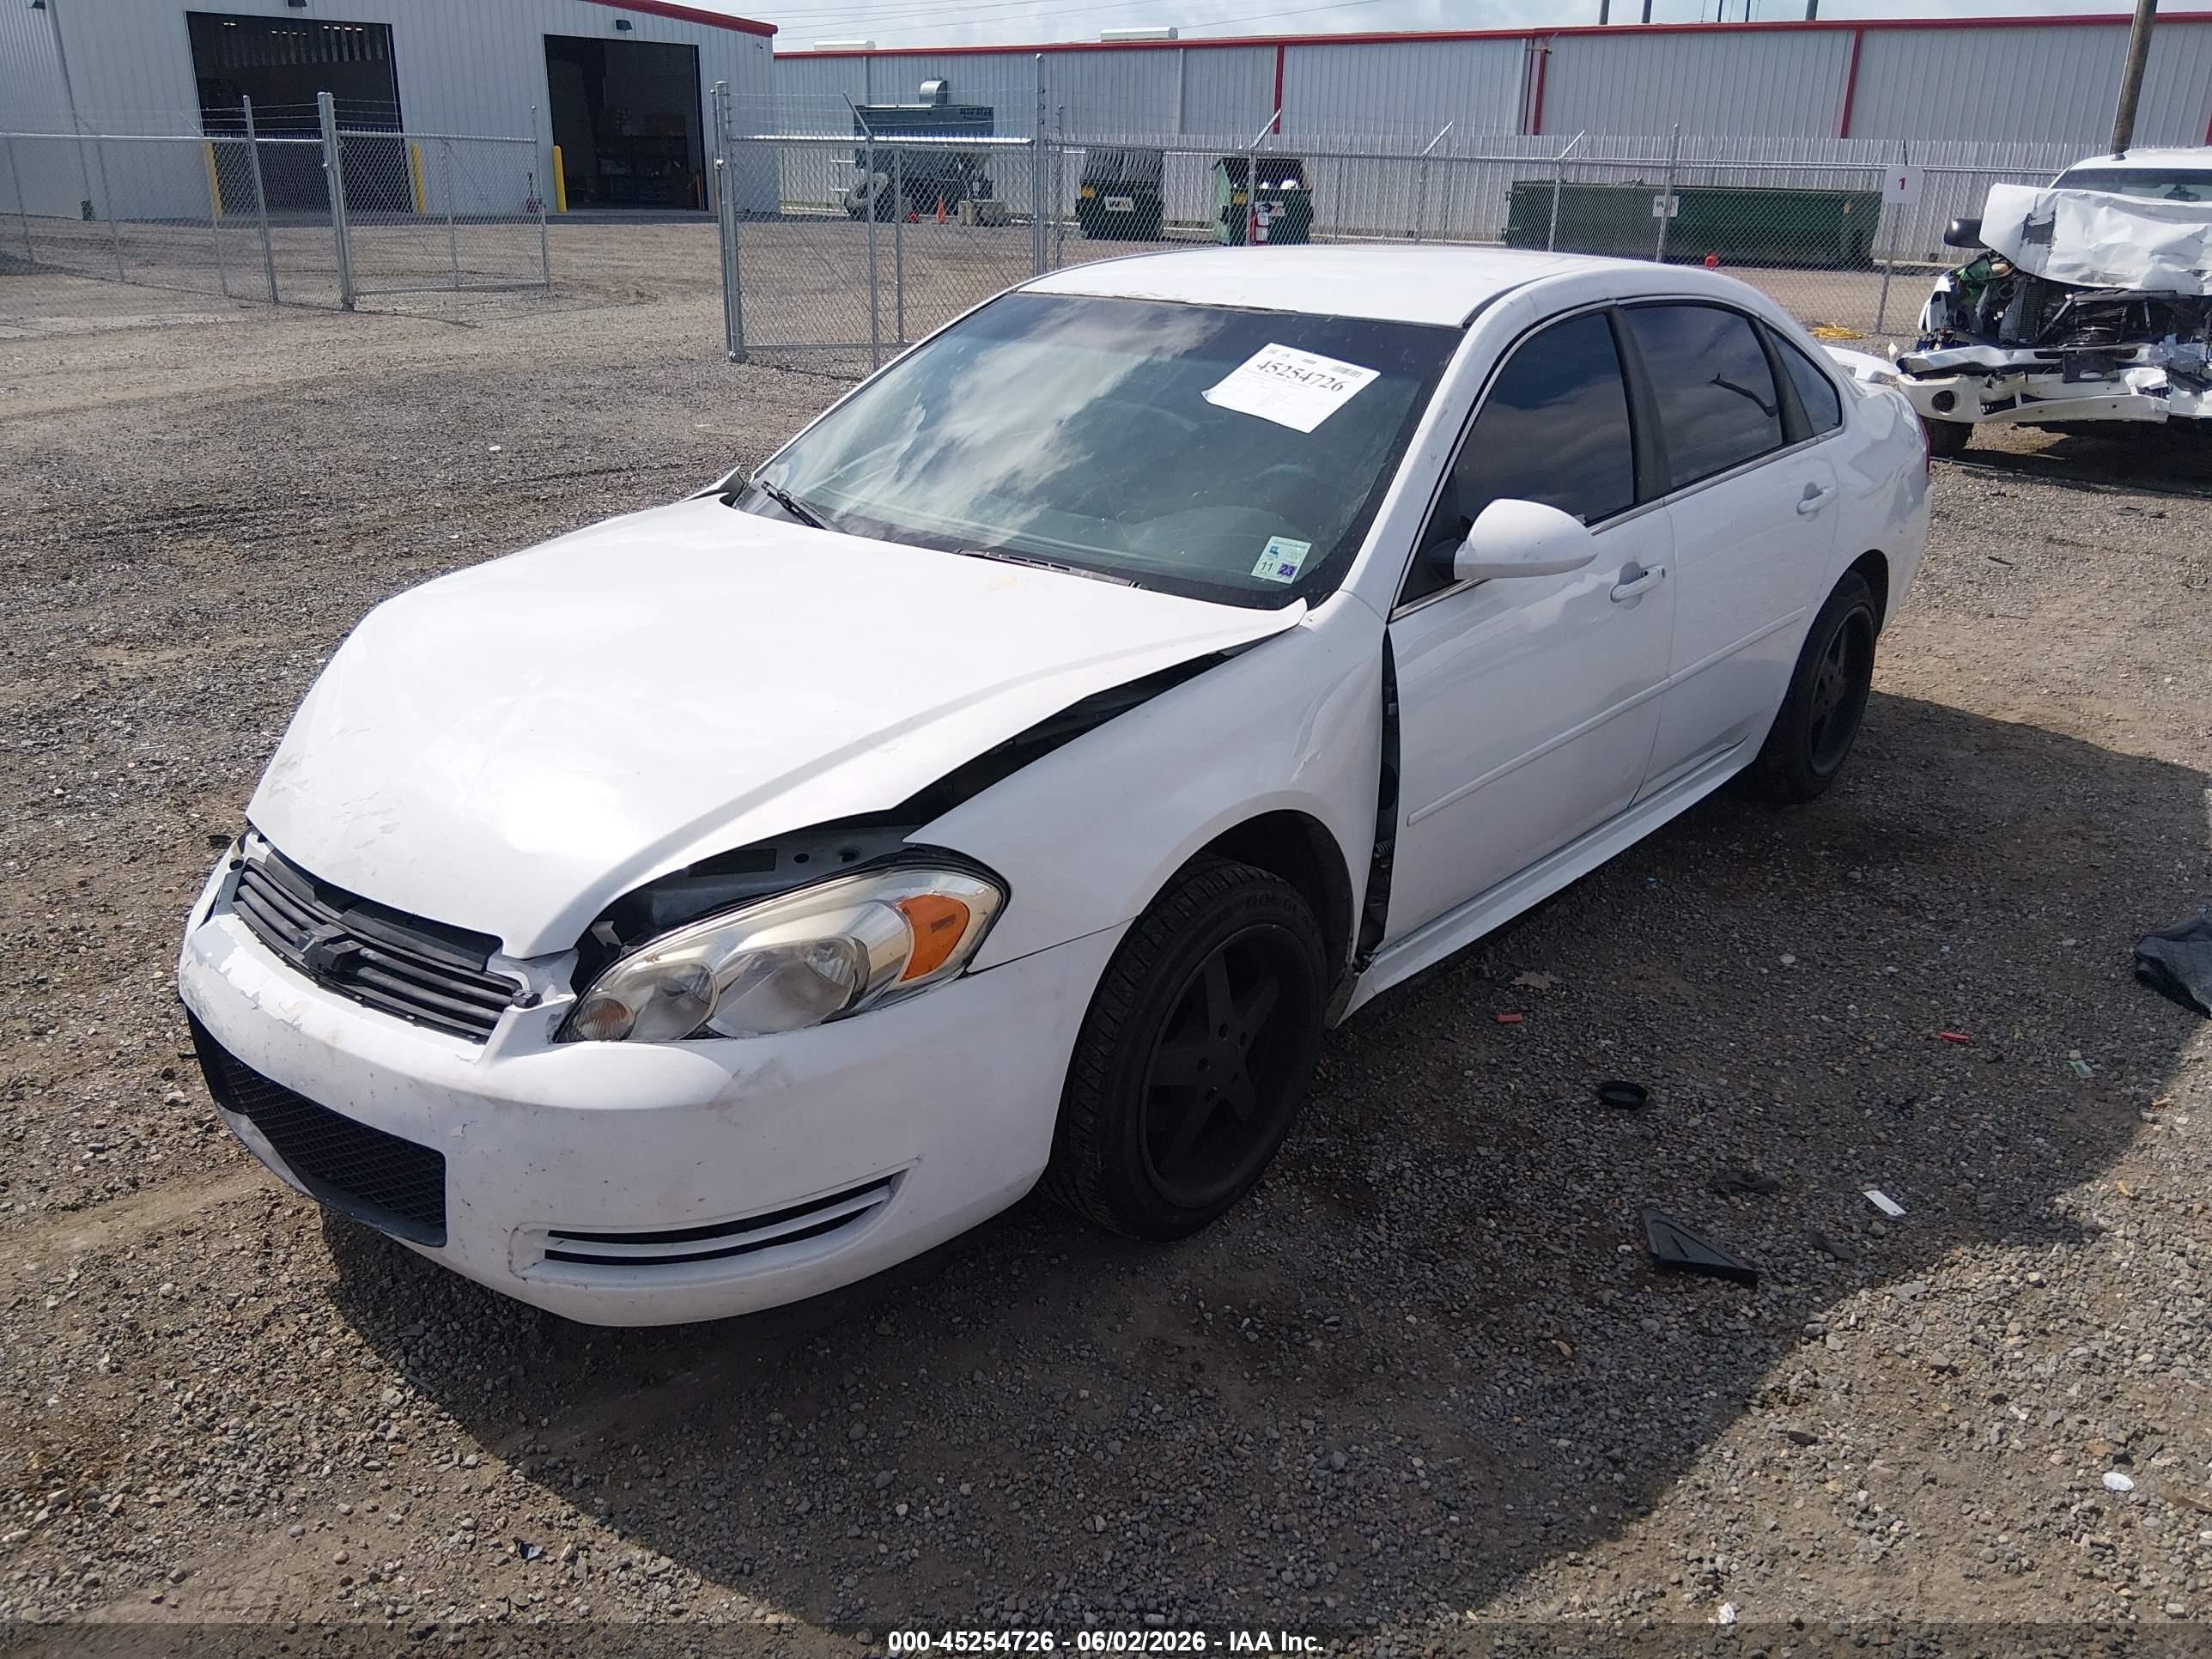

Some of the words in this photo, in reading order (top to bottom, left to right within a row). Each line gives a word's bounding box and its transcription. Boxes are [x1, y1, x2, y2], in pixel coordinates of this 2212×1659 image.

[1898, 177, 1906, 191] 1
[1256, 360, 1348, 392] 45254726
[1261, 562, 1273, 572] 11
[1278, 563, 1295, 576] 23
